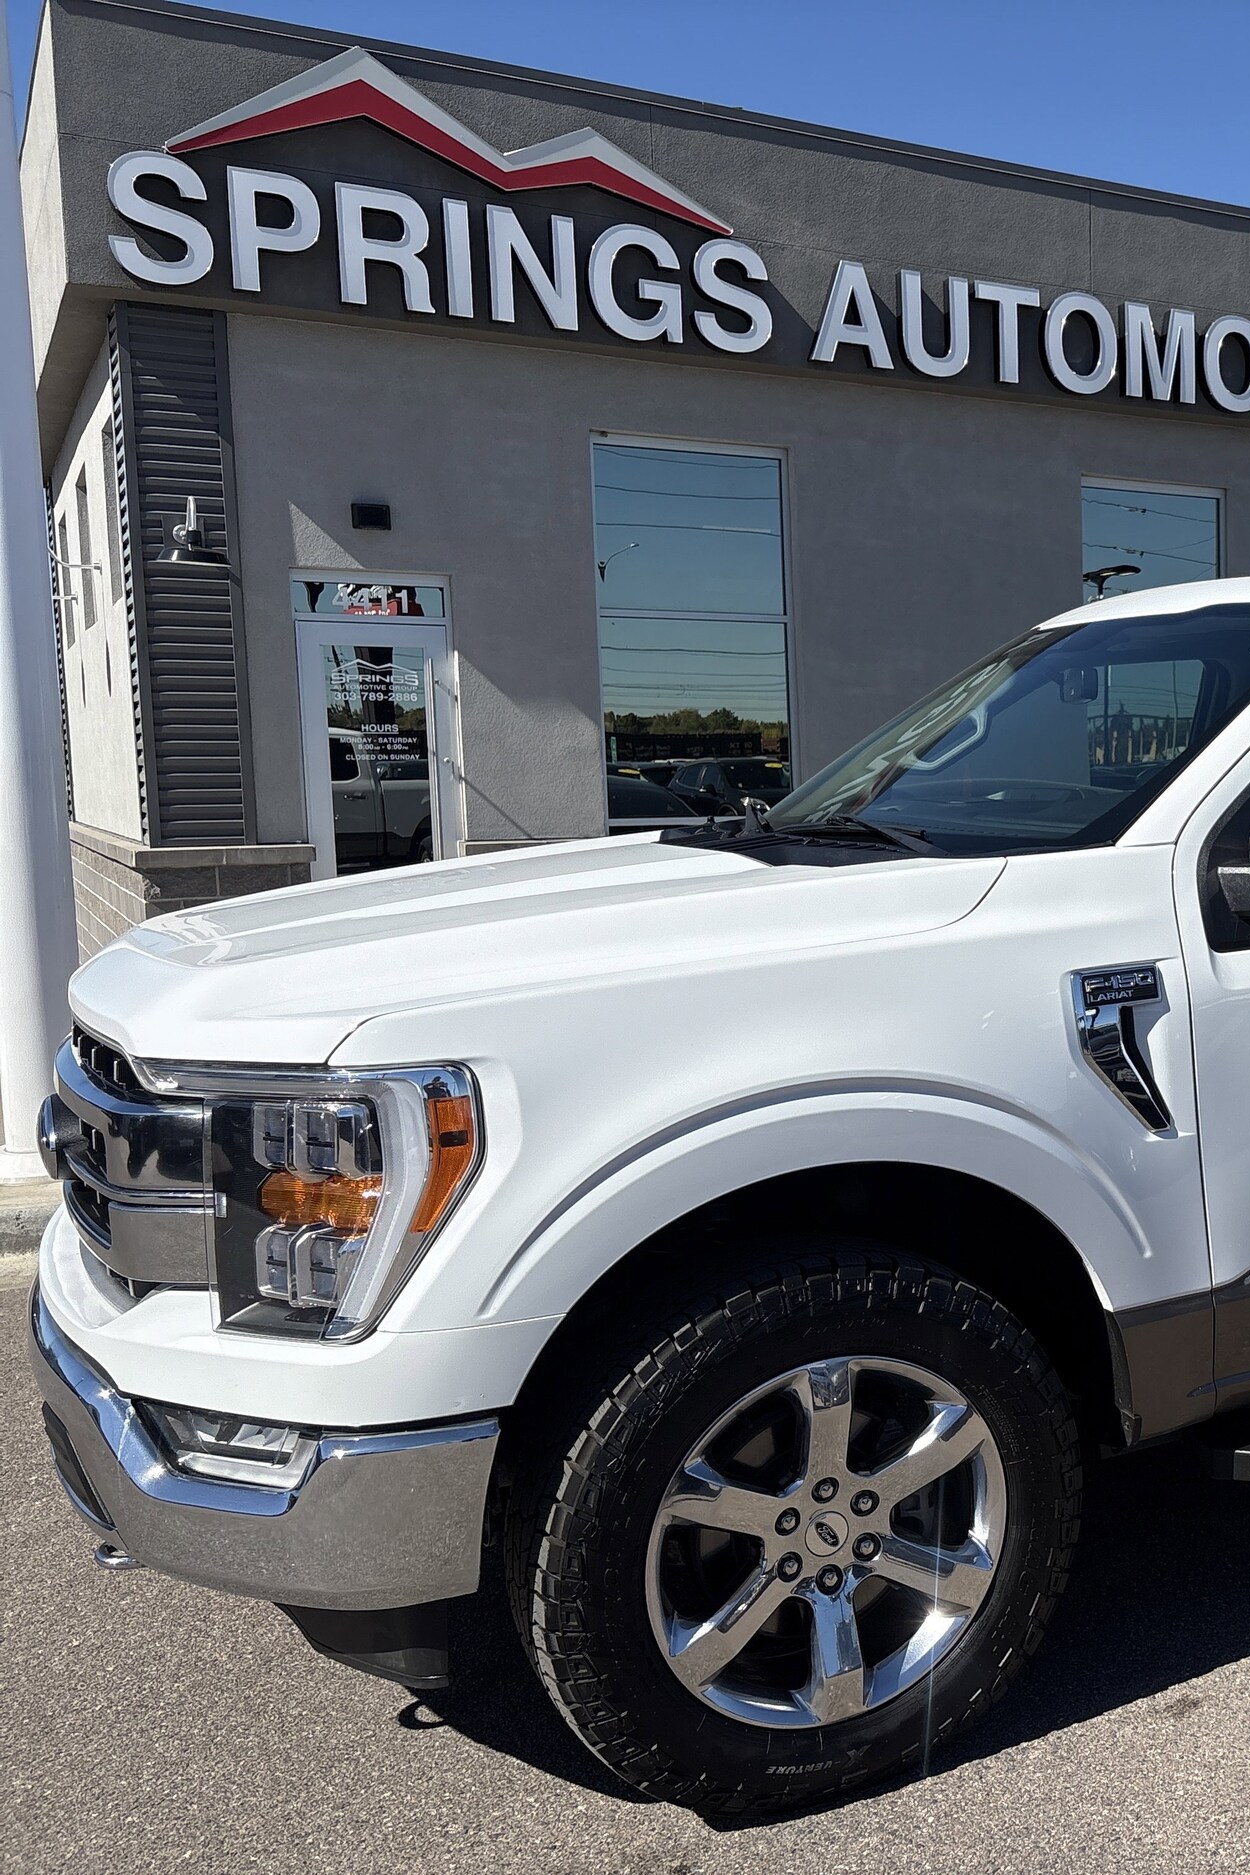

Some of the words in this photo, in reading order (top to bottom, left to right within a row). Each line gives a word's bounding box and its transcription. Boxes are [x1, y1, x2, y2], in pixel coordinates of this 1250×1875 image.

[106, 150, 773, 355] SPRINGS
[332, 586, 409, 614] 4411
[331, 673, 419, 686] SPRINGS
[334, 691, 418, 702] 303-789-2886
[361, 724, 399, 734] HOURS
[1084, 972, 1155, 993] F-150
[1089, 989, 1134, 1003] LARIAT
[817, 1525, 837, 1545] Ford
